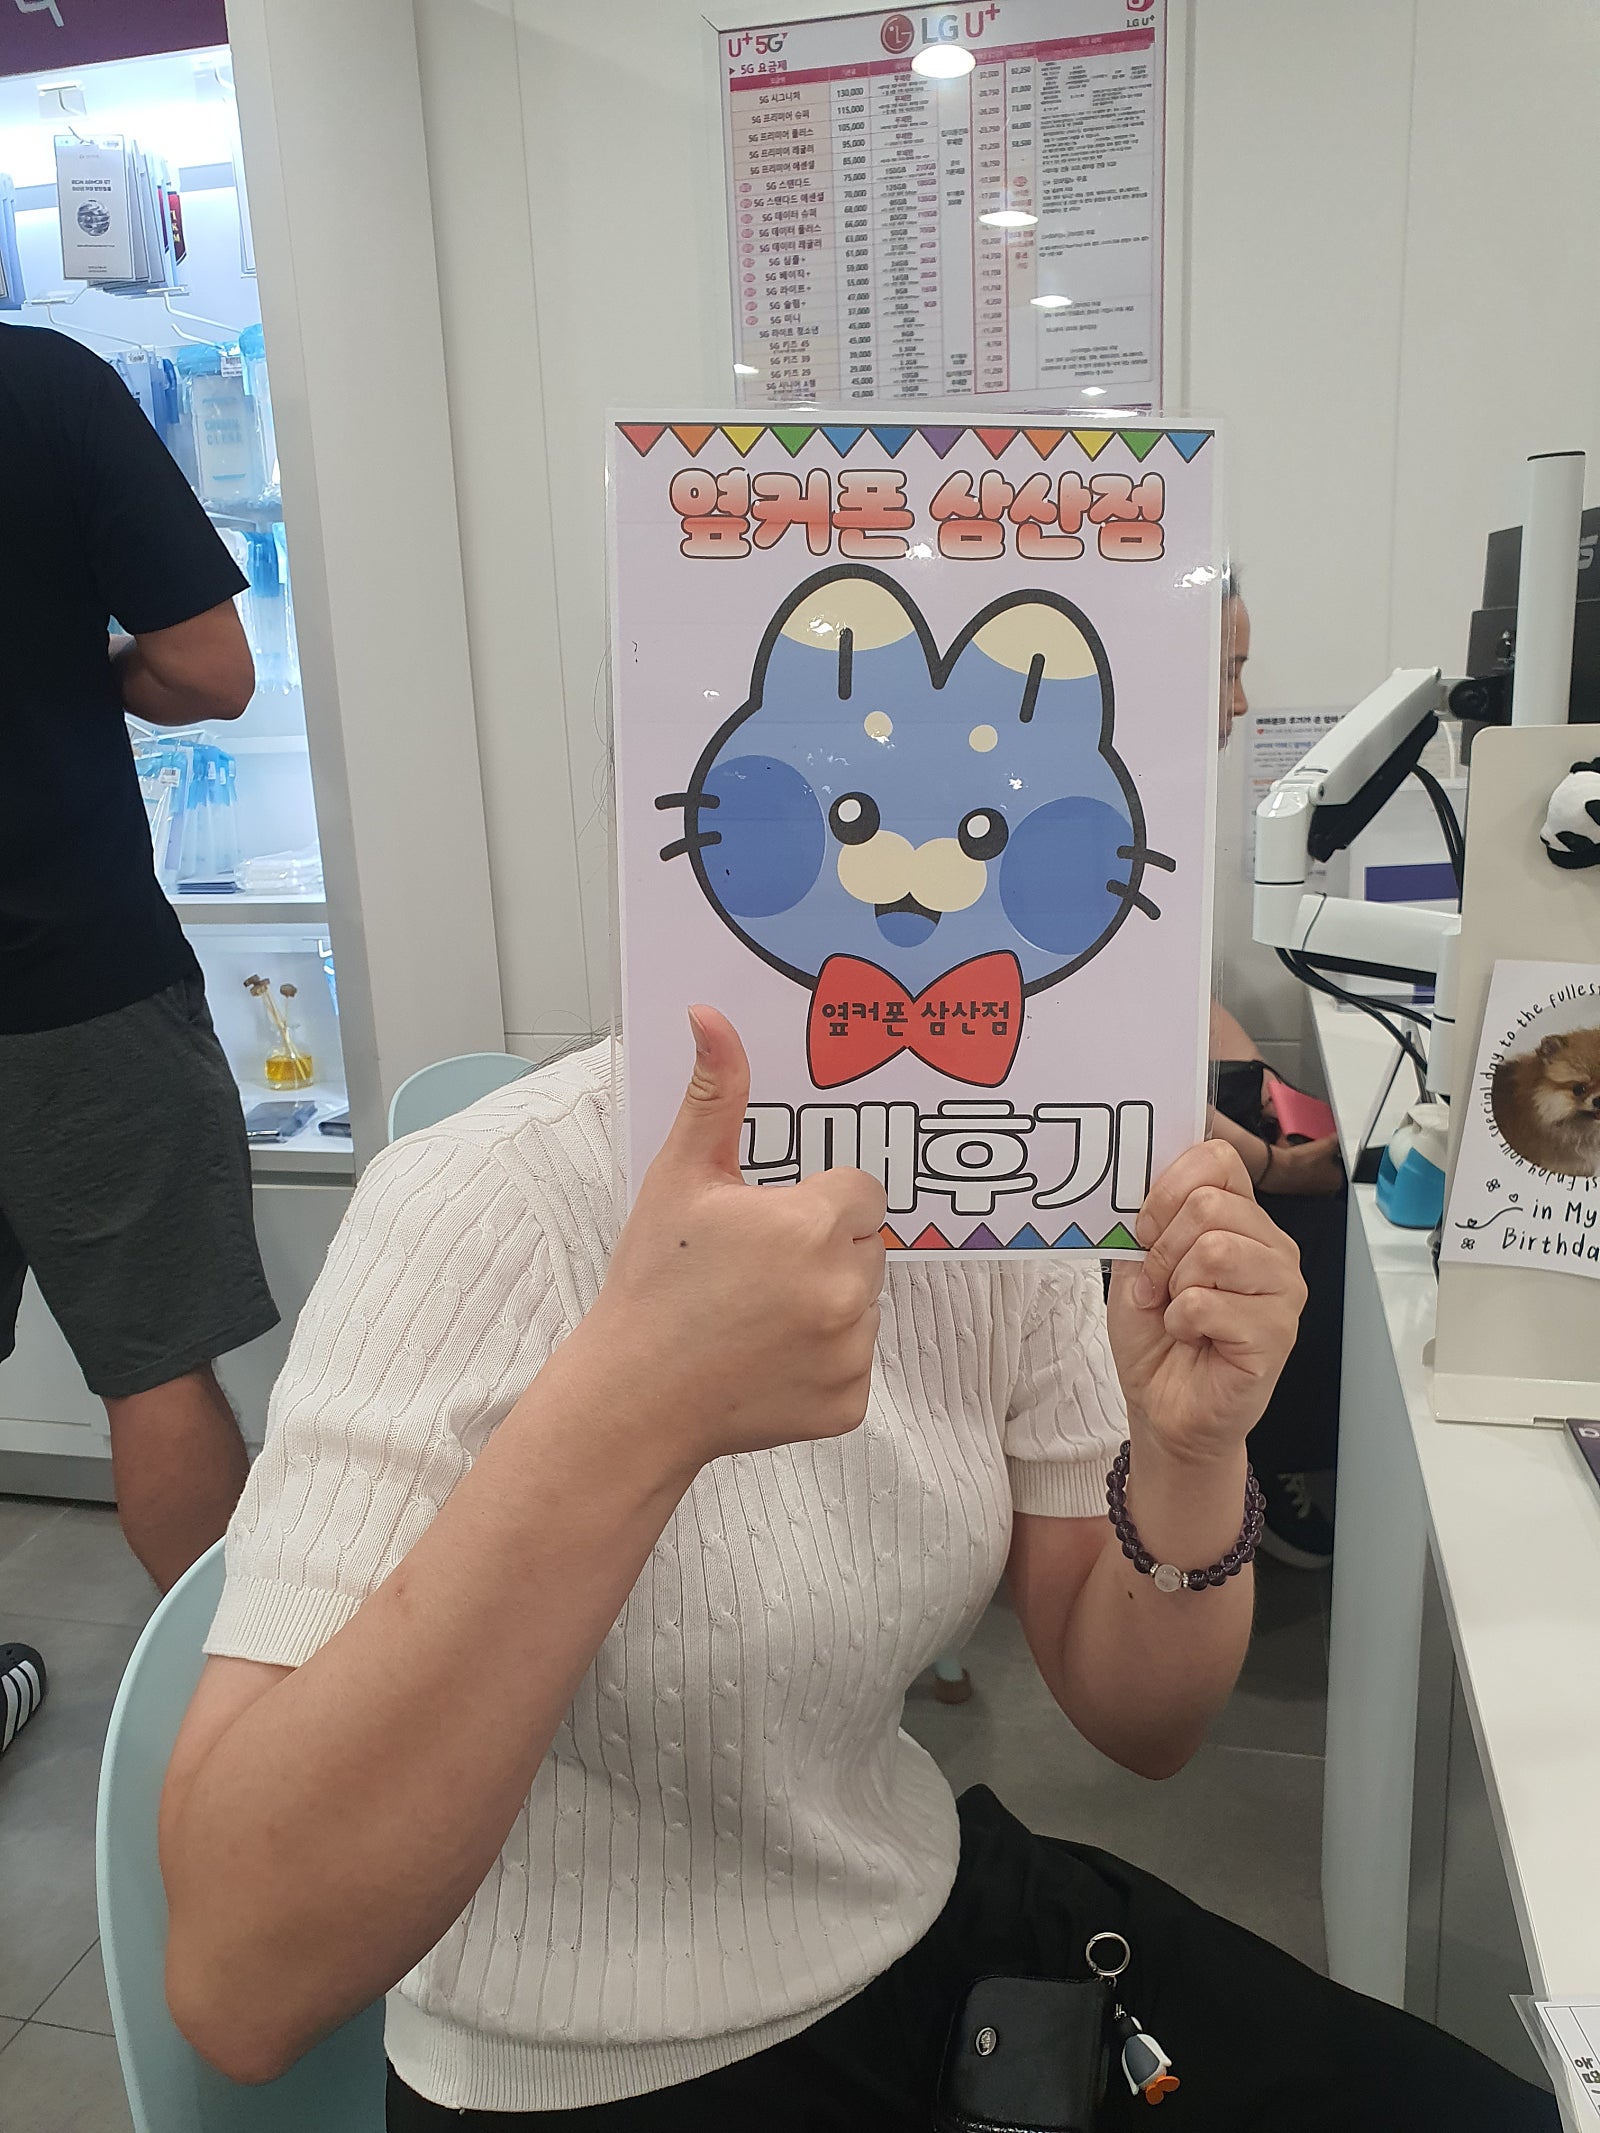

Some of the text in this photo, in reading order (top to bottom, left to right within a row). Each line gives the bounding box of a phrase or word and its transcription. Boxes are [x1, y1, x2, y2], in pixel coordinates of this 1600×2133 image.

[921, 3, 1000, 44] LG U+
[1126, 18, 1139, 28] LG
[741, 60, 787, 74] 5G 요금제
[836, 87, 864, 98] 130,000
[669, 466, 1165, 562] 옆커폰 삼산점
[821, 1000, 1010, 1037] 옆커폰 삼산점
[1480, 1052, 1505, 1080] day
[1499, 1031, 1516, 1048] to
[1516, 1003, 1543, 1028] the
[1549, 983, 1600, 1009] fulles
[1532, 1199, 1598, 1228] in My
